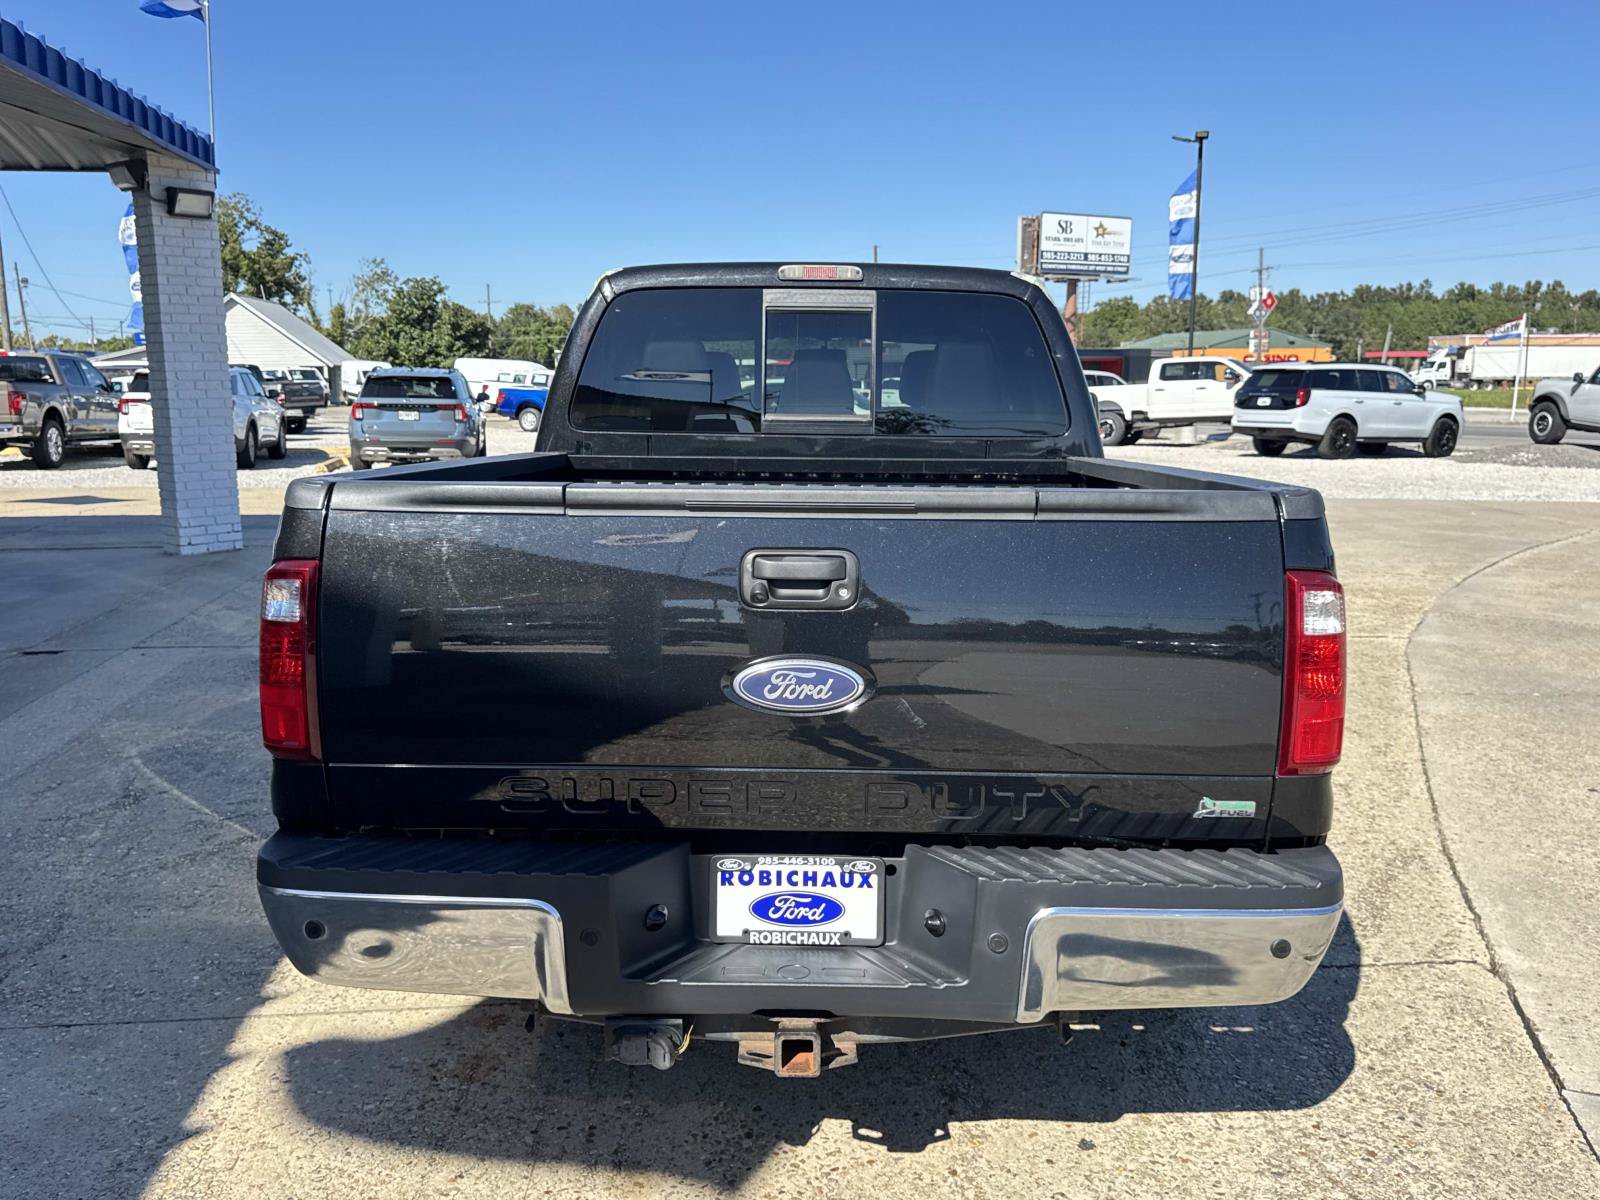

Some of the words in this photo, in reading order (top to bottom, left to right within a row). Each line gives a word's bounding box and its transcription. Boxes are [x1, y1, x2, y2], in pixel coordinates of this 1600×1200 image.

[1057, 219, 1073, 235] SB
[1243, 354, 1299, 363] CSINO
[763, 670, 834, 700] Ford
[499, 776, 804, 816] SUPER
[864, 782, 1100, 822] DUTY
[758, 857, 835, 865] 985-446-3100
[721, 870, 873, 888] ROBICHAUX
[768, 895, 826, 920] Ford
[749, 932, 841, 946] ROBICHAUX
